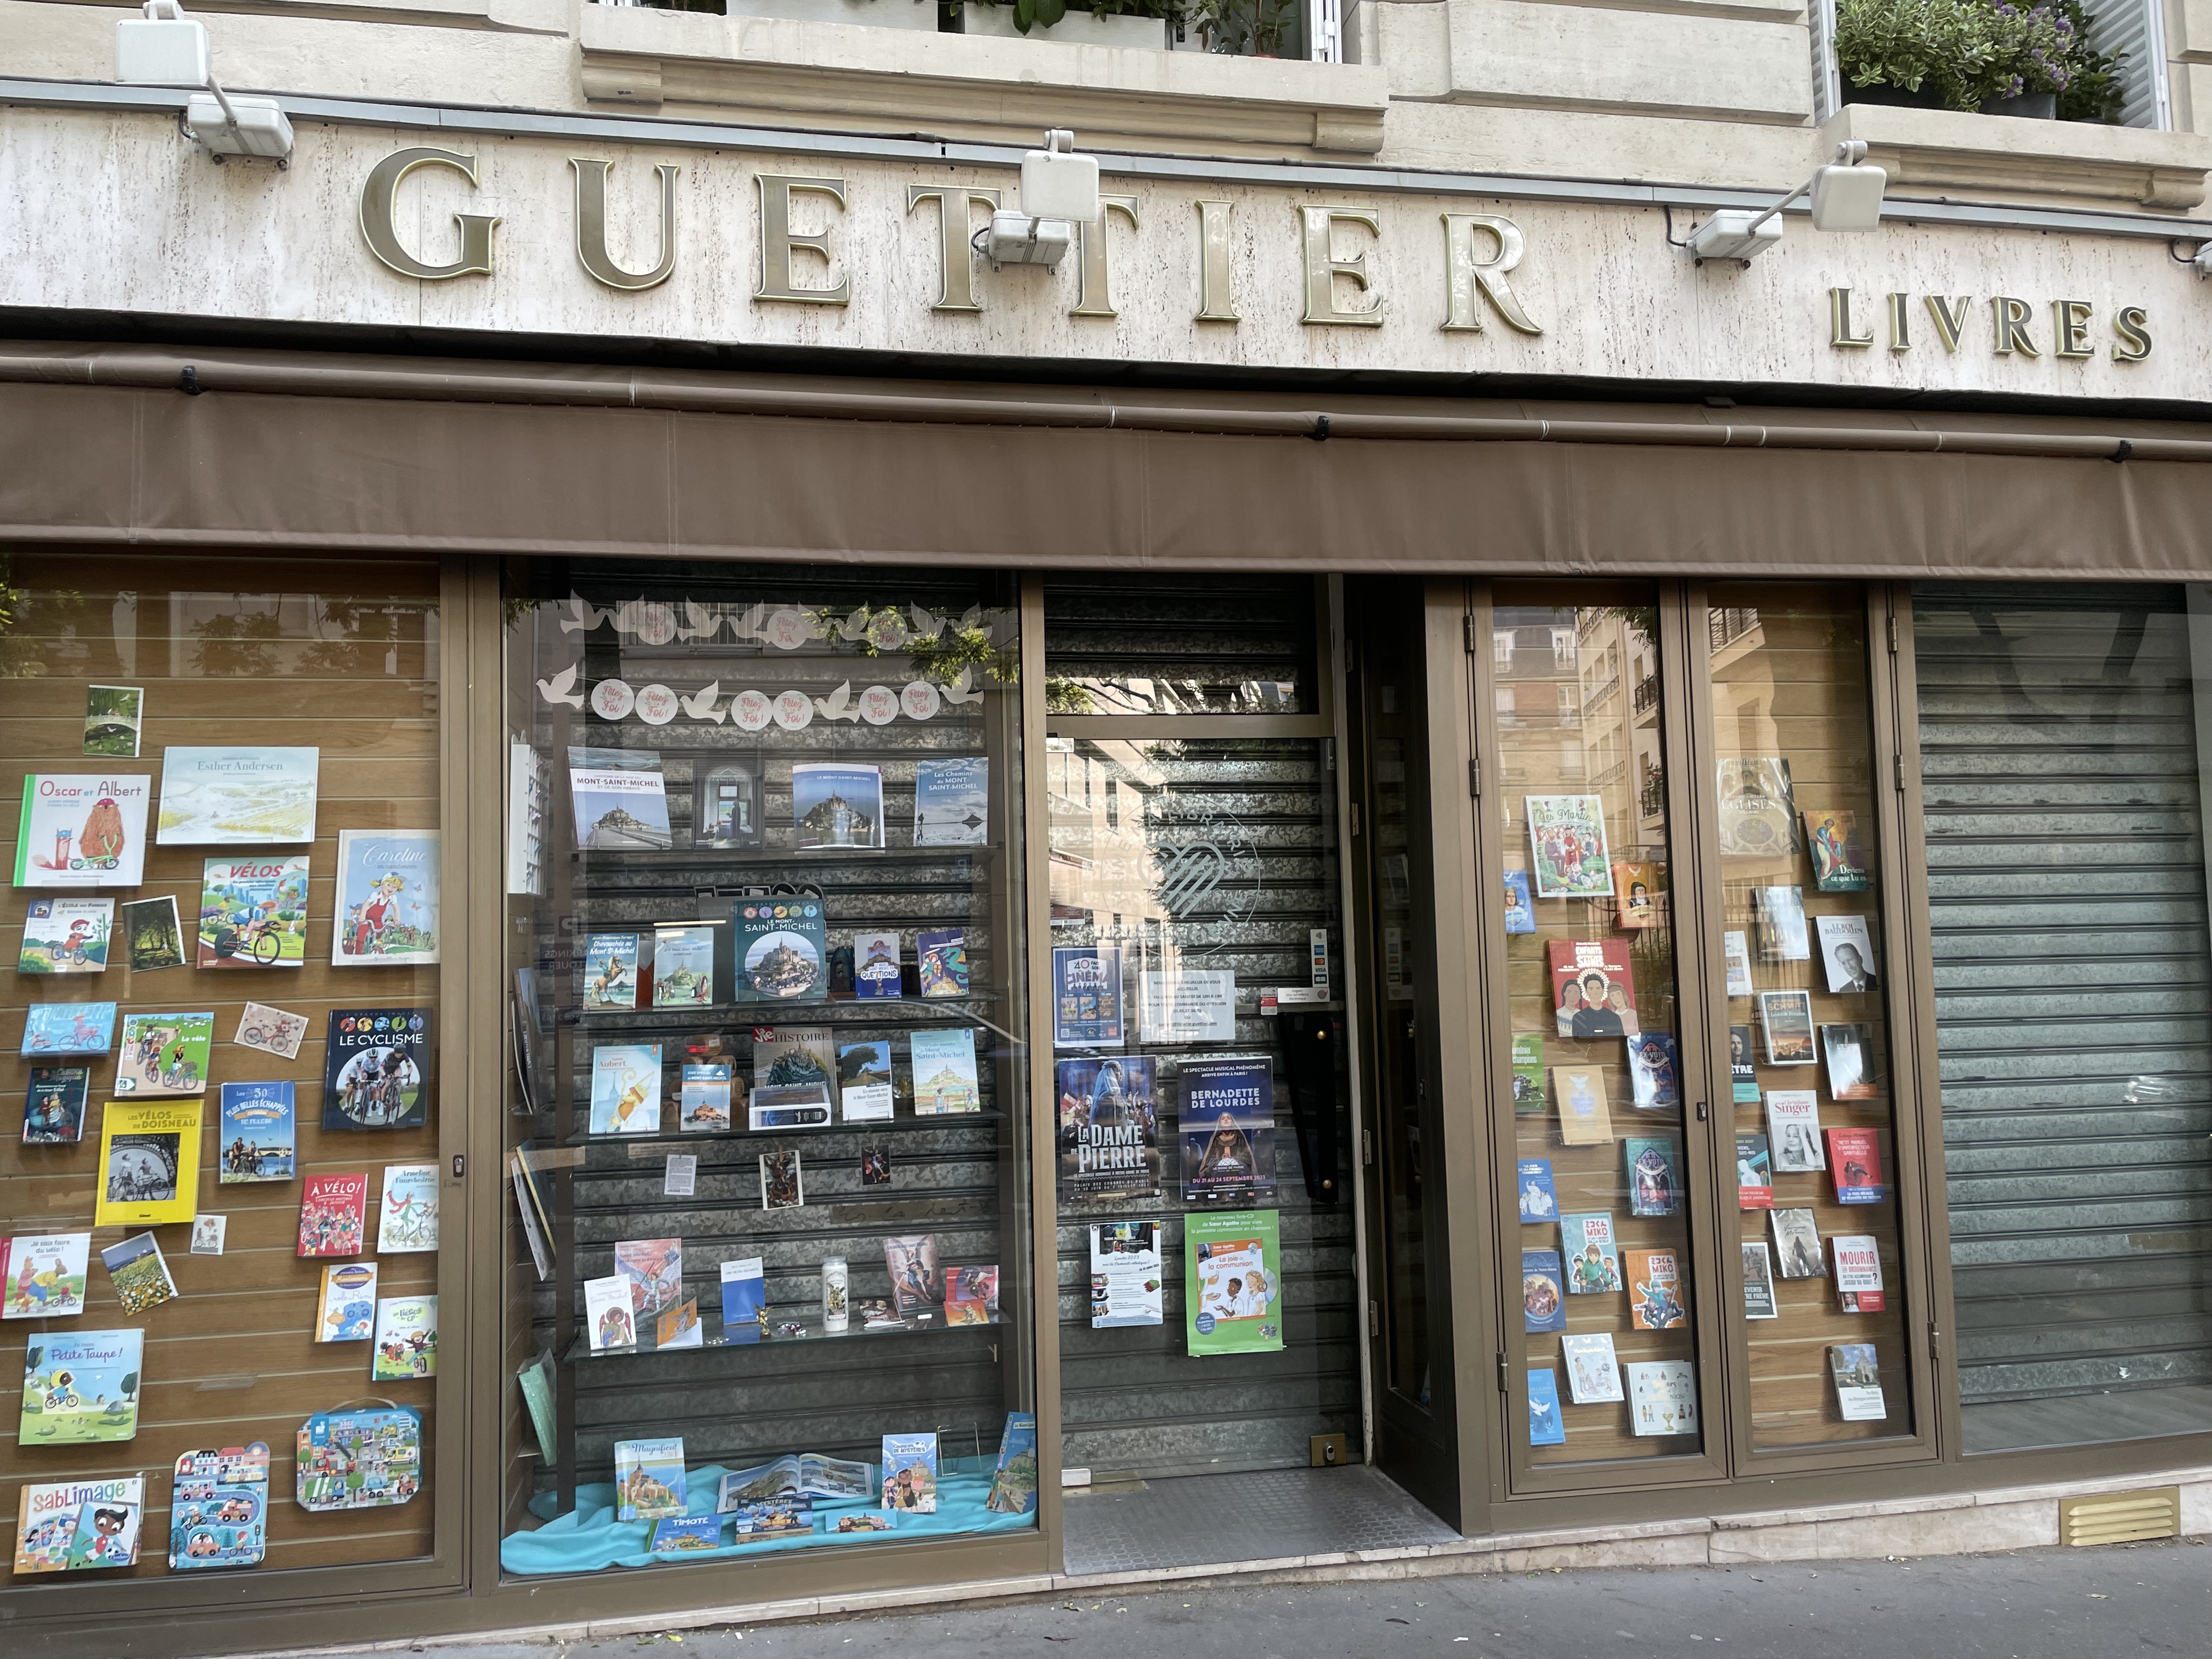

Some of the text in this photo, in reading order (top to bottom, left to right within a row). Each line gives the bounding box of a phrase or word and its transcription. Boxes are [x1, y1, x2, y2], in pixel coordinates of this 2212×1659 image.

[359, 145, 1544, 336] GUETTIER
[1829, 286, 2154, 362] LIVRES
[198, 760, 283, 771] Esther Andersen
[577, 777, 659, 787] MONT-SAINT-MICHEL
[928, 783, 978, 791] SAINT-MICHEL
[40, 781, 82, 797] Oscar
[98, 780, 142, 797] Albert
[1557, 808, 1594, 822] Martin
[363, 844, 427, 867] Caroline
[230, 861, 284, 878] VÉLOS
[1839, 864, 1866, 874] Deviens
[1851, 873, 1859, 882] tu
[744, 922, 817, 932] SAINT-MICHEL
[1575, 946, 1603, 956] ENFANTS
[1576, 955, 1605, 968] SAINTS
[1066, 969, 1109, 985] CINÉMA
[340, 1033, 424, 1046] LE CYCLISME
[775, 1032, 830, 1042] HISTOIRE
[916, 1051, 966, 1060] Saint-Michel
[254, 1087, 268, 1099] 50
[1190, 1087, 1260, 1099] BERNADETTE
[259, 1098, 290, 1116] ÉCHAPPÉES
[1192, 1097, 1260, 1108] DE LOURDES
[1775, 1102, 1811, 1115] Singer
[138, 1109, 172, 1120] VÉLOS
[142, 1119, 196, 1128] DOISNEAU
[1077, 1124, 1143, 1147] LA DAME
[1077, 1143, 1147, 1173] PIERRE
[311, 1182, 321, 1197] À
[1586, 1228, 1608, 1236] MIKO
[1839, 1251, 1876, 1265] MOURIR
[1216, 1260, 1254, 1269] communion
[1652, 1265, 1674, 1273] MIKO
[52, 1348, 82, 1361] Petite
[631, 1443, 677, 1455] Magnificat
